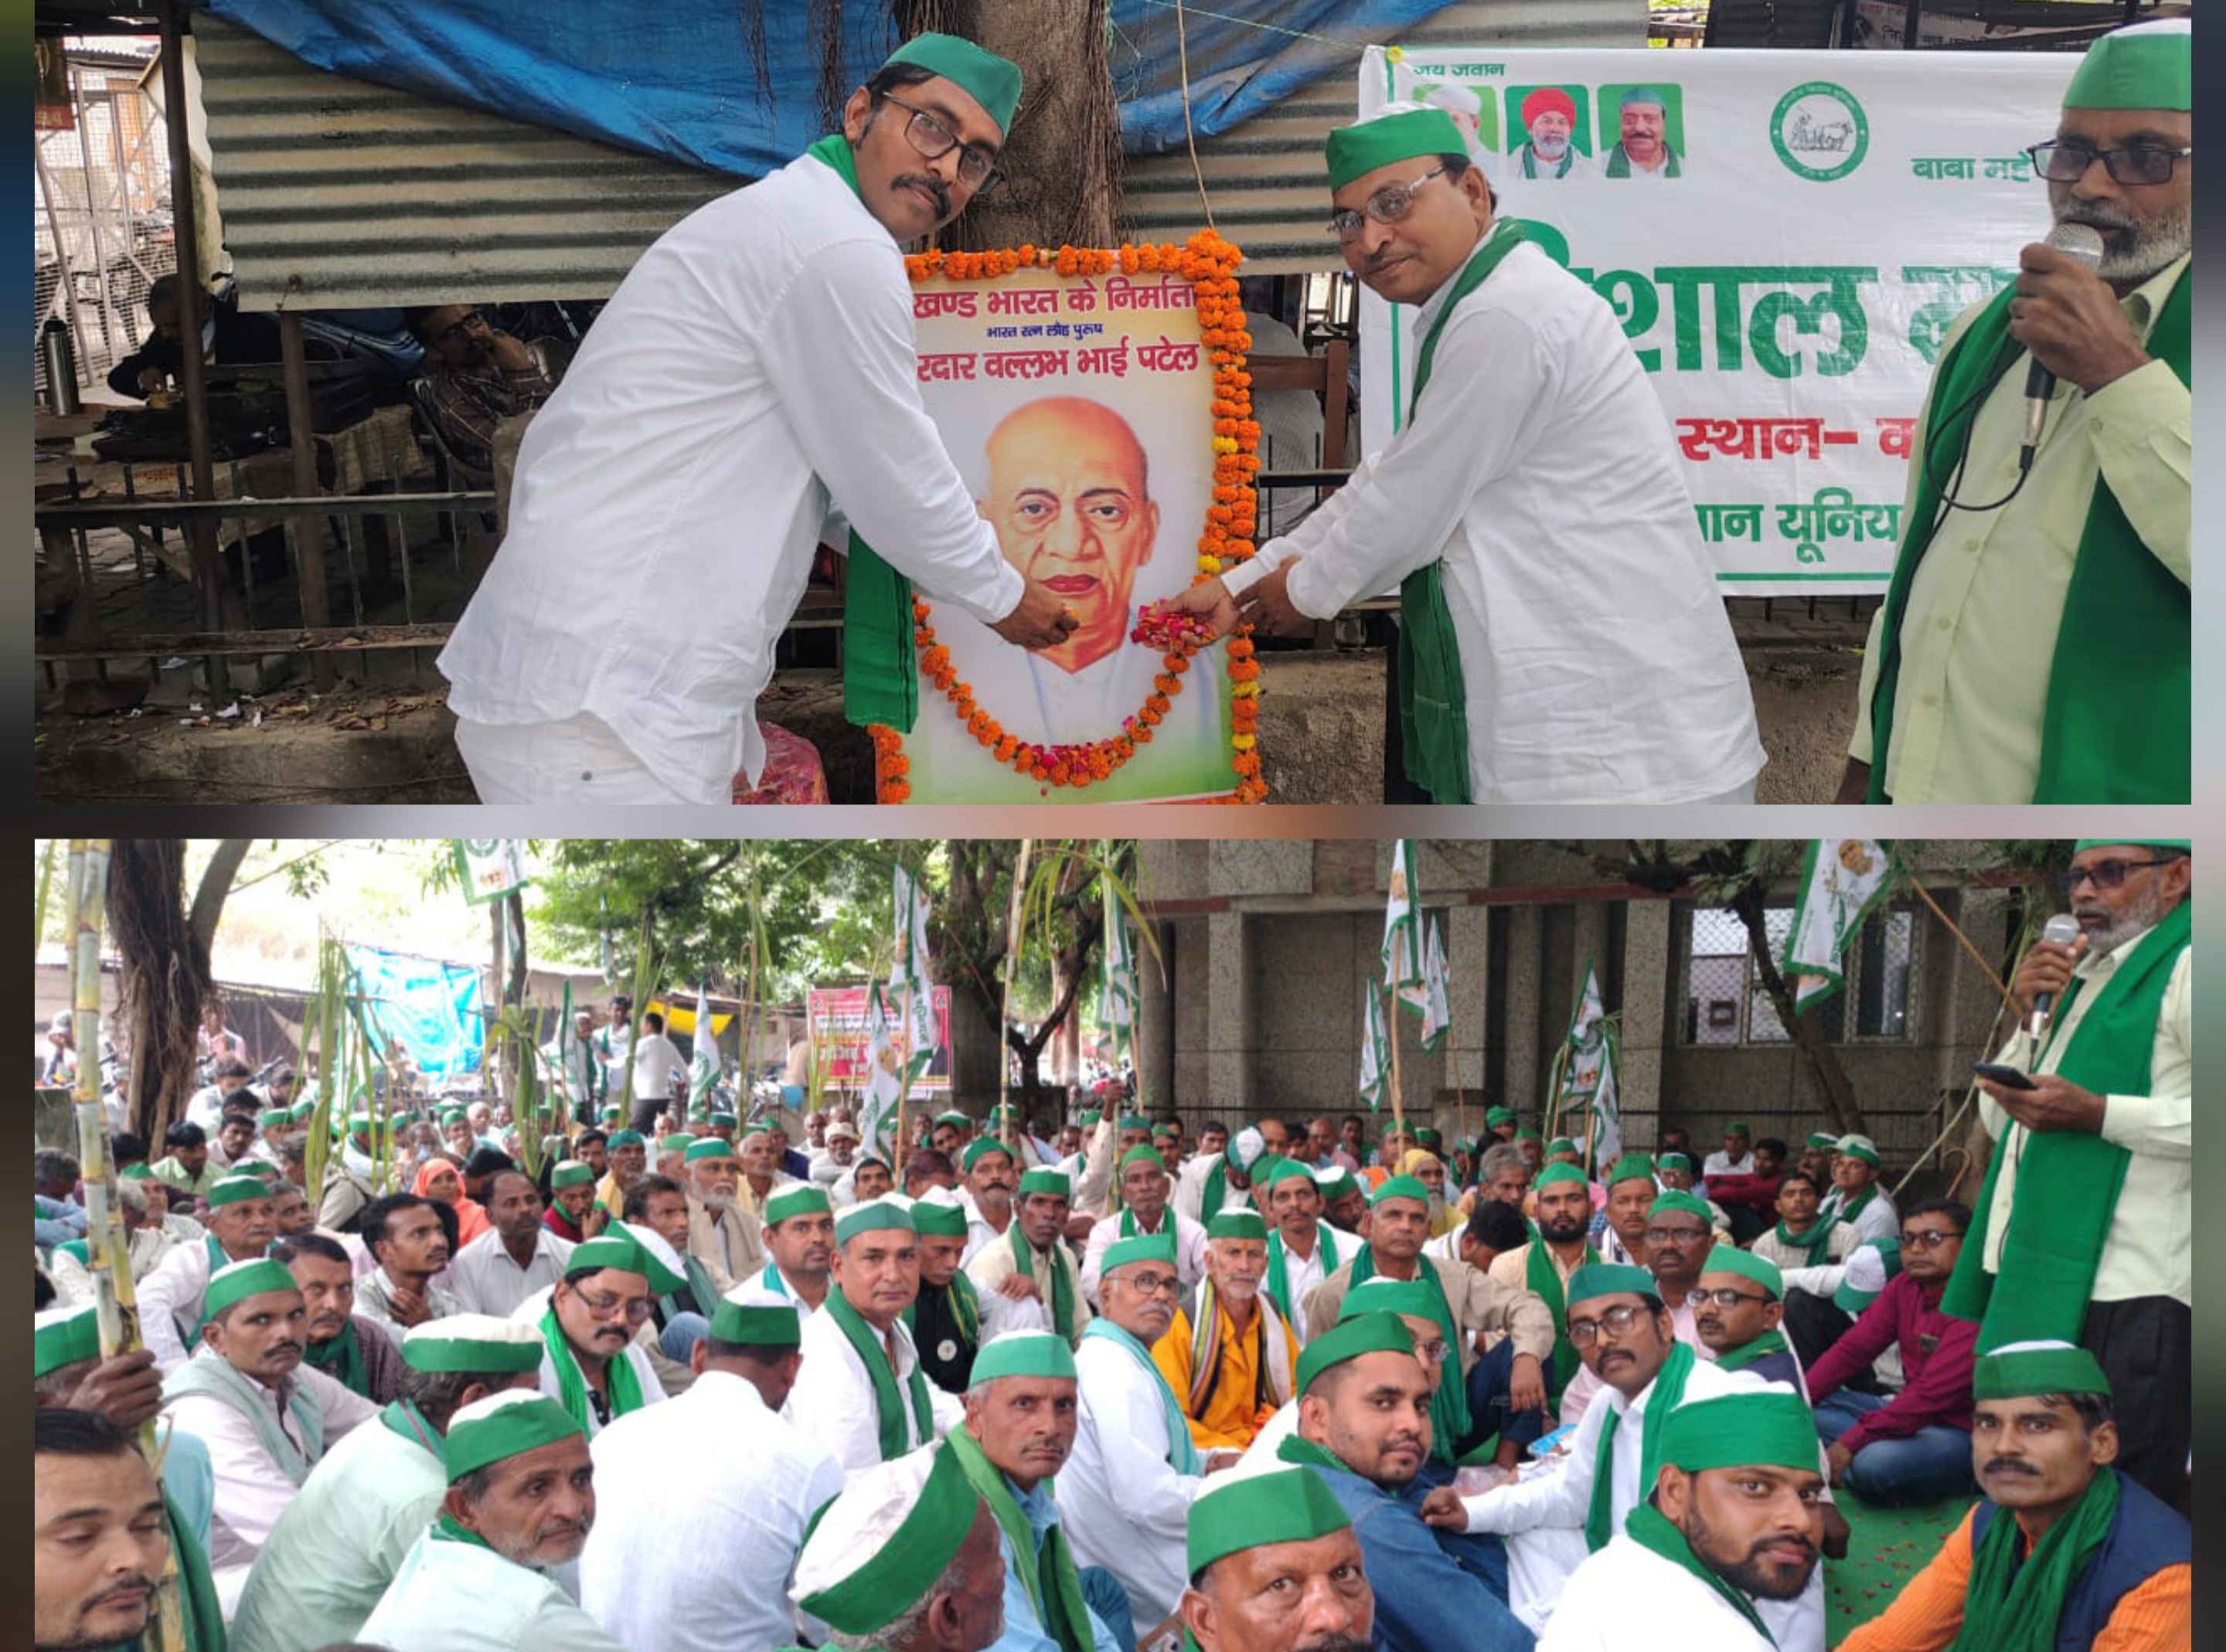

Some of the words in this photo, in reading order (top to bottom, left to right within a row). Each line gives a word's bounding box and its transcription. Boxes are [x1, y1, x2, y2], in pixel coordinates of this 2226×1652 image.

[1413, 65, 1445, 76] जय
[1450, 63, 1505, 76] जवान
[1910, 158, 1976, 179] बाबा
[914, 291, 979, 318] खण्ड
[987, 289, 1059, 314] भारत
[1066, 279, 1098, 312] के
[1105, 275, 1199, 311] निर्माता
[987, 327, 1017, 338] भारत
[917, 352, 978, 382] रदार
[982, 349, 1070, 379] वल्लभ
[1077, 335, 1128, 377] भाई
[1136, 335, 1200, 372] पटेल
[1775, 487, 1904, 564] यूनिय
